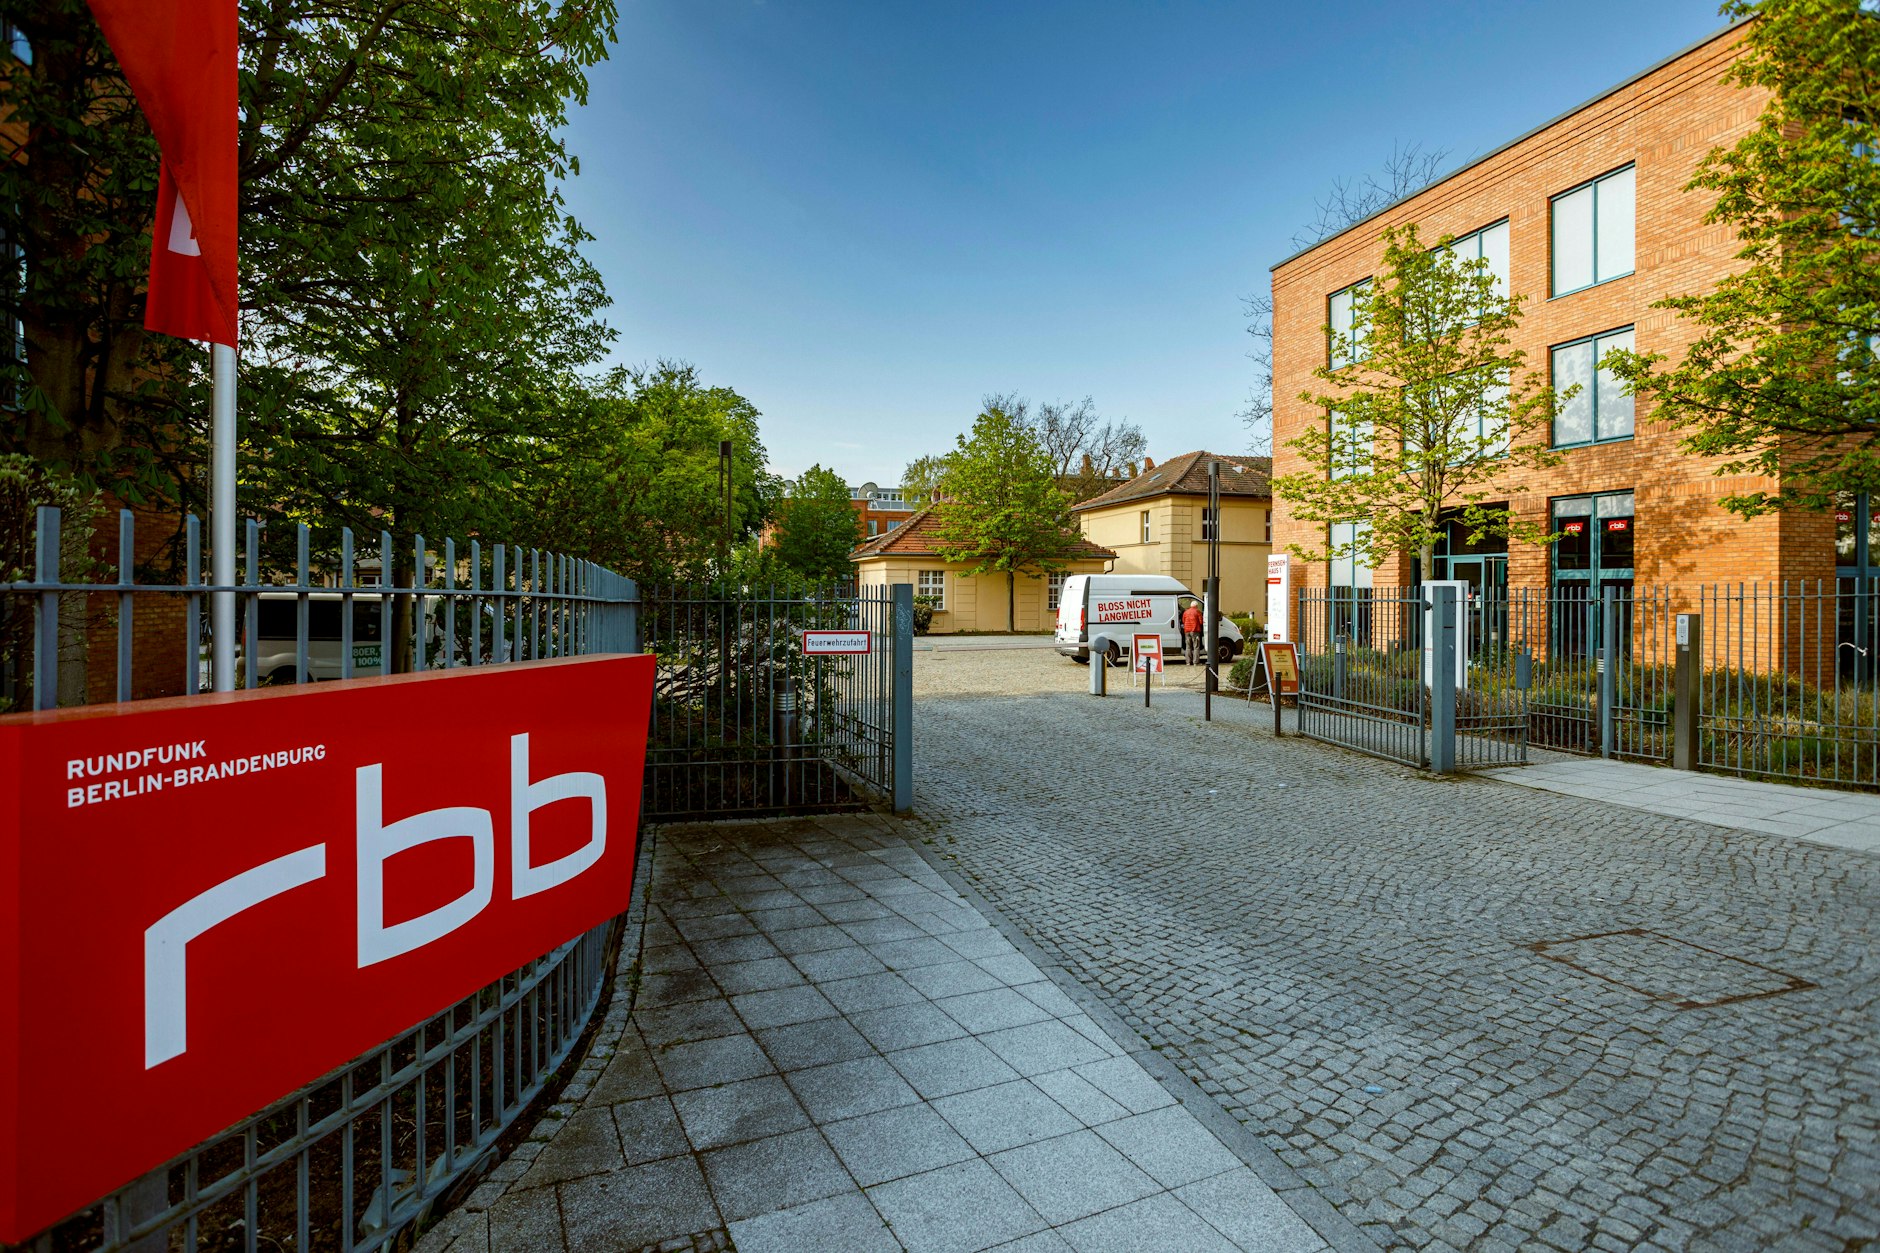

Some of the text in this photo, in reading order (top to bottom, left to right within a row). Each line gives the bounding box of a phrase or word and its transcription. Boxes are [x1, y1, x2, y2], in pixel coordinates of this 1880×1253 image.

[1609, 521, 1625, 529] rbb
[1098, 599, 1152, 612] BLOSS NICHT
[1099, 609, 1152, 622] LANGWEILEN
[807, 638, 867, 647] Feuerwehrzufahrt
[67, 740, 207, 780] RUNDFUNK
[67, 744, 326, 808] BERLIN-BRANDENBURG
[145, 733, 607, 1070] rbb
